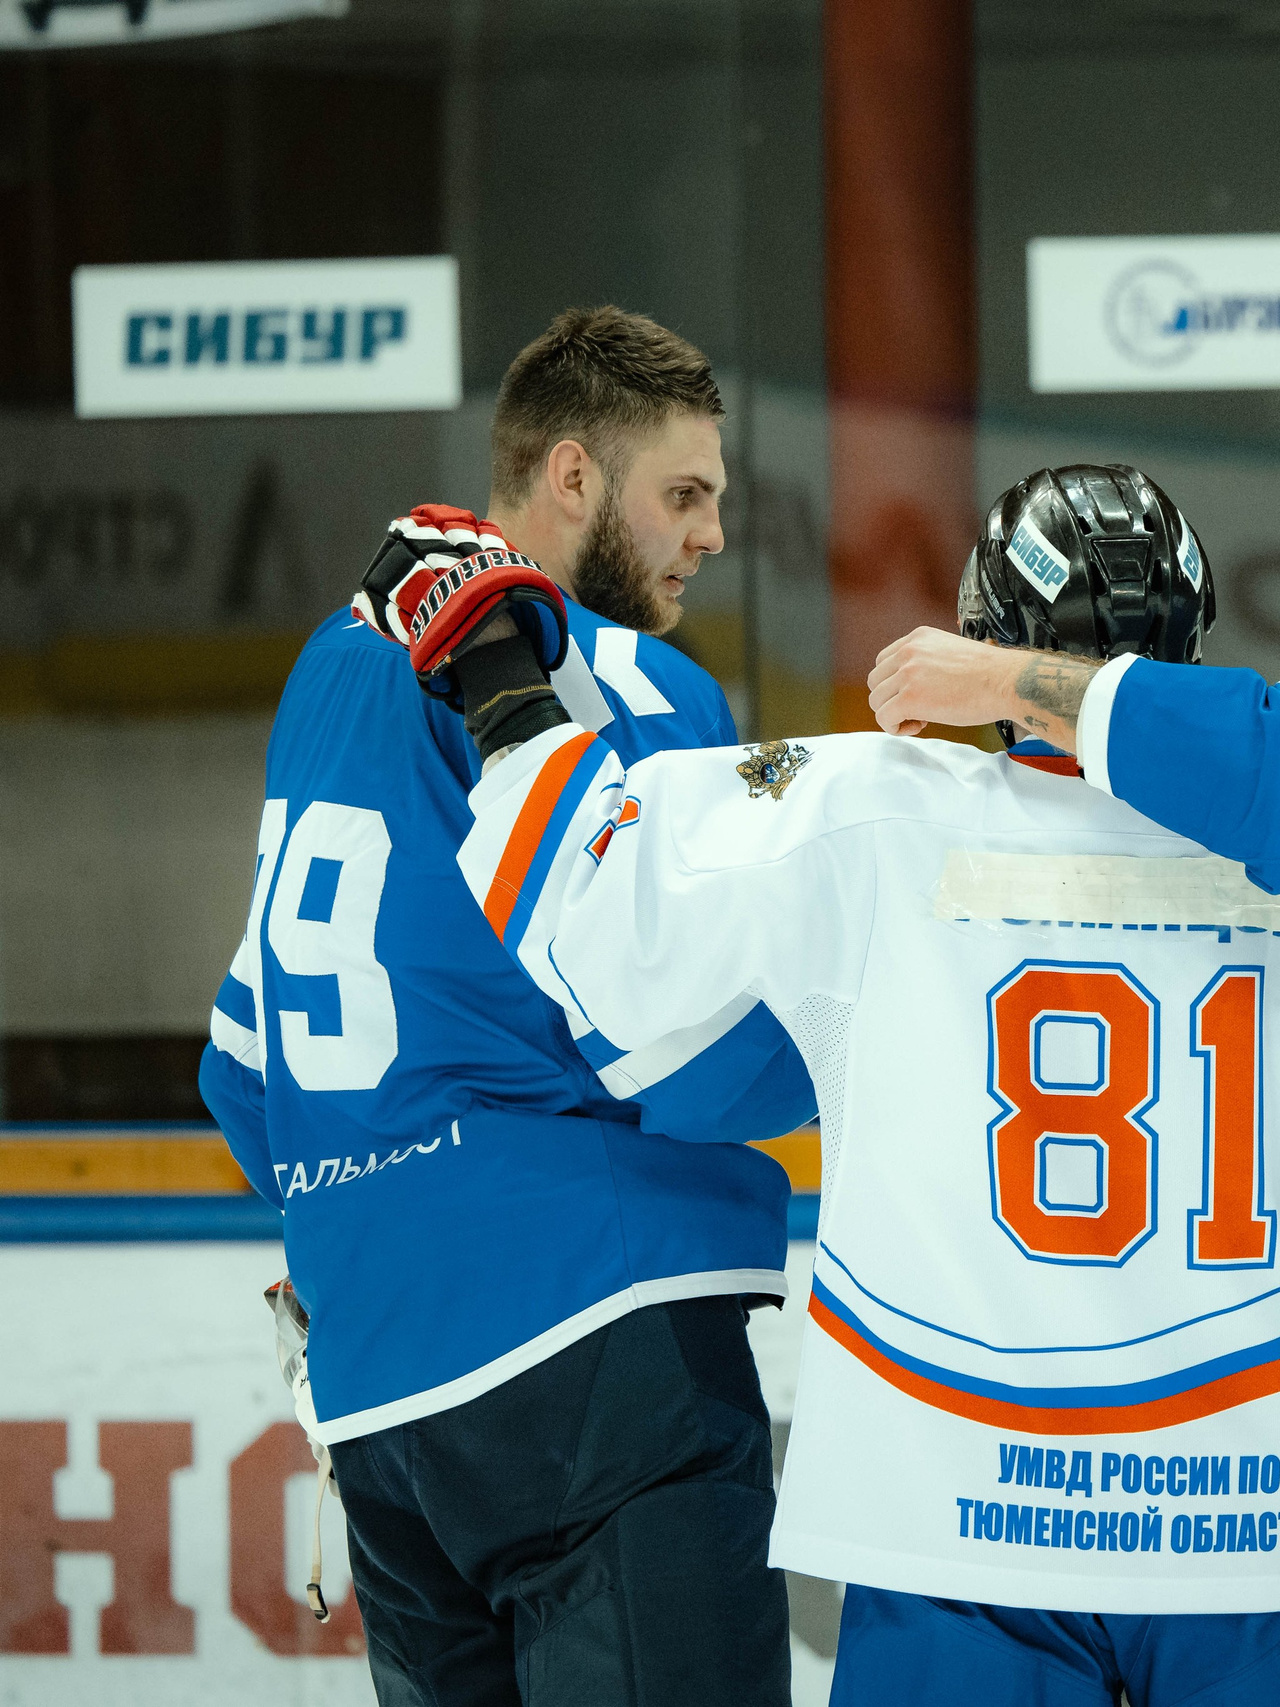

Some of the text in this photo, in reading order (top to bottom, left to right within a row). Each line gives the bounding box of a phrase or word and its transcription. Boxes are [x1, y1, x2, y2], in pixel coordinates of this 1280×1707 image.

[125, 308, 406, 364] СИБУР
[1010, 524, 1069, 587] СИБУР
[986, 958, 1277, 1271] 81
[998, 1443, 1093, 1498] УМВД
[1100, 1452, 1230, 1496] РОССИИ
[956, 1497, 1163, 1552] ТЮМЕНСКОЙ
